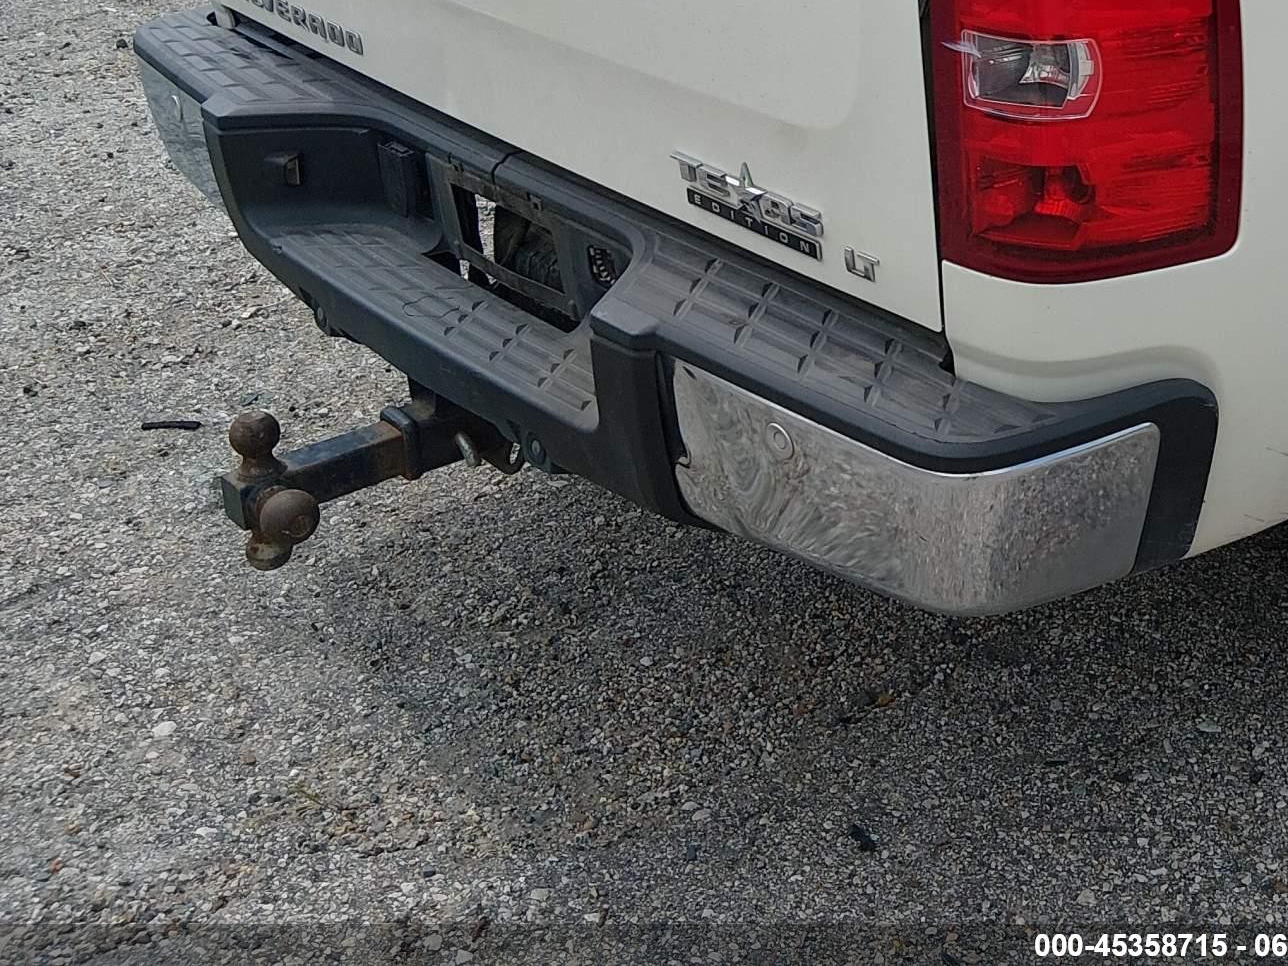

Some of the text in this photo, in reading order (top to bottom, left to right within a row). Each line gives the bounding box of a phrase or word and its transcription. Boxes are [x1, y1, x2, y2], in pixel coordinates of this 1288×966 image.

[670, 150, 824, 237] TEXAS
[693, 194, 811, 254] EDITION
[844, 245, 880, 283] LT
